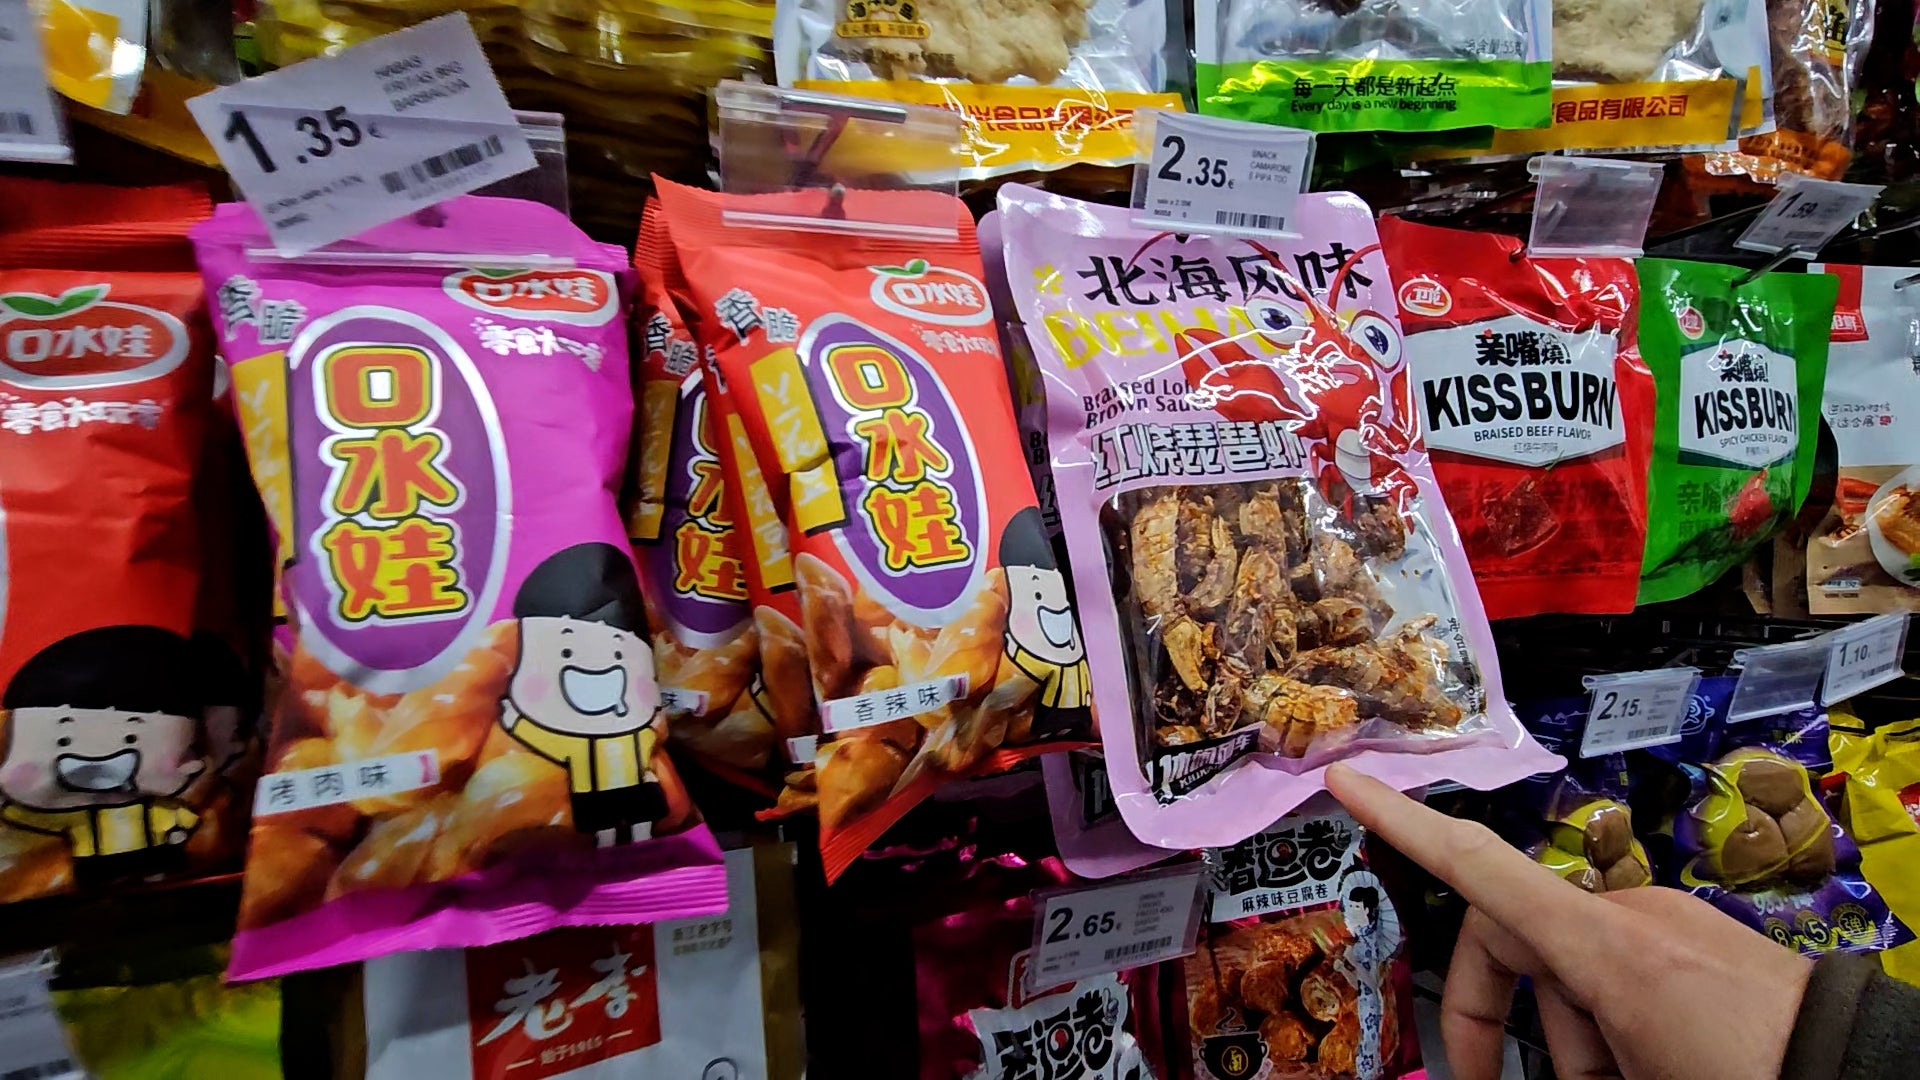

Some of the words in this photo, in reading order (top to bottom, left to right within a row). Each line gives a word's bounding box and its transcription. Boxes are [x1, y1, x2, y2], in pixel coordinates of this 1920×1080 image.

[1293, 73, 1457, 98] 每一天都是新起点
[1291, 101, 1324, 114] Every
[1327, 100, 1349, 112] day
[1352, 100, 1361, 110] is
[1364, 101, 1372, 109] a
[1399, 99, 1457, 112] beginning
[1551, 95, 1689, 124] 食品有限公司
[1077, 243, 1373, 306] 北海风味
[892, 281, 983, 309] 口水娃
[714, 287, 800, 345] 香脆
[7, 325, 154, 363] 口水娃
[1423, 371, 1616, 431] KISSBURN
[1475, 426, 1523, 442] BRAISED
[1527, 426, 1554, 437] BEEF
[1557, 425, 1592, 441] FLAVOR
[1719, 435, 1738, 448] SPICY
[1740, 434, 1767, 444] CHICKEN
[828, 345, 970, 571] 口水娃
[1091, 419, 1307, 490] 红烧琵琶虾
[325, 347, 469, 621] 口水娃
[854, 684, 941, 723] 香辣味
[1242, 884, 1329, 913] 麻辣味豆腐卷
